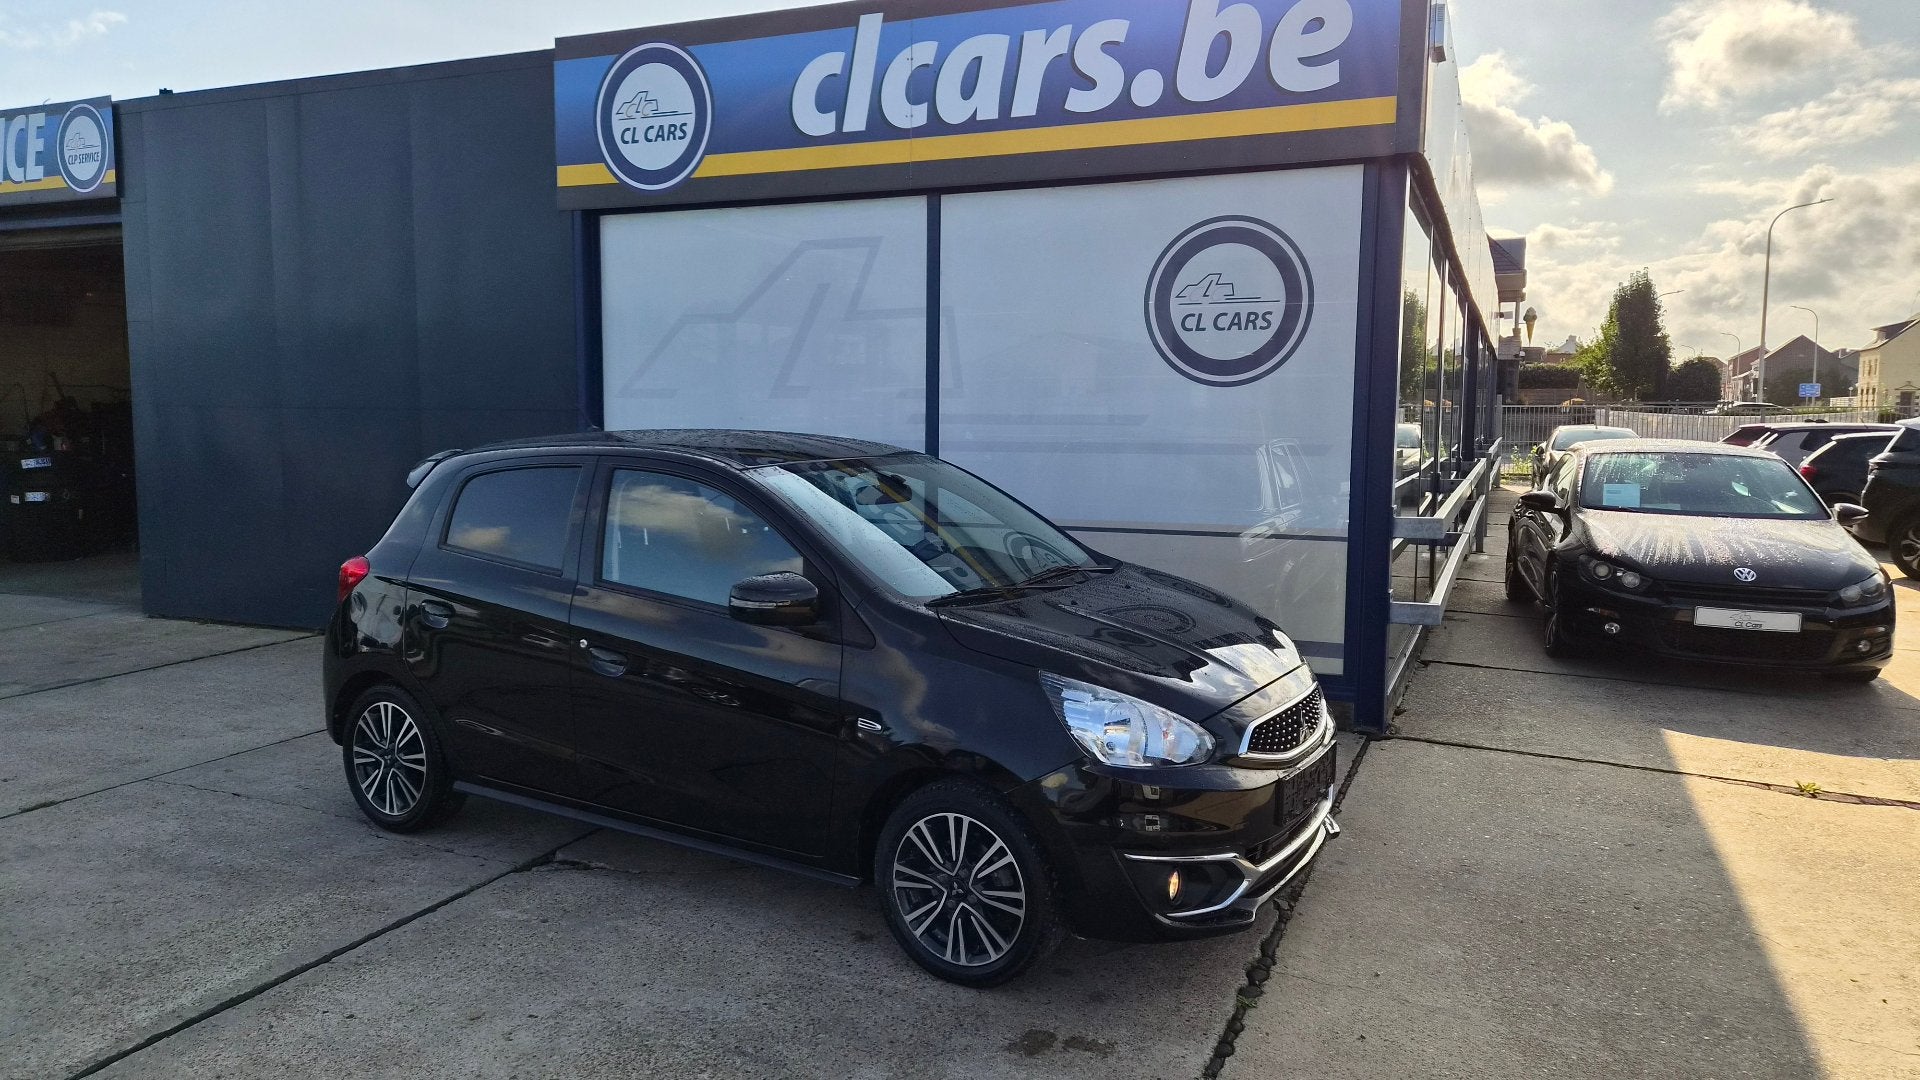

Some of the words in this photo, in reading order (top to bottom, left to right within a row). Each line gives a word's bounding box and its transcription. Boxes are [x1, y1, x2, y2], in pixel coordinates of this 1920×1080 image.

[791, 0, 1353, 137] clcars.be
[620, 127, 639, 145] CL
[644, 122, 688, 143] CARS
[68, 154, 78, 165] CLP
[79, 152, 99, 164] SERVICE
[1180, 313, 1206, 332] CL
[1213, 310, 1273, 331] CARS
